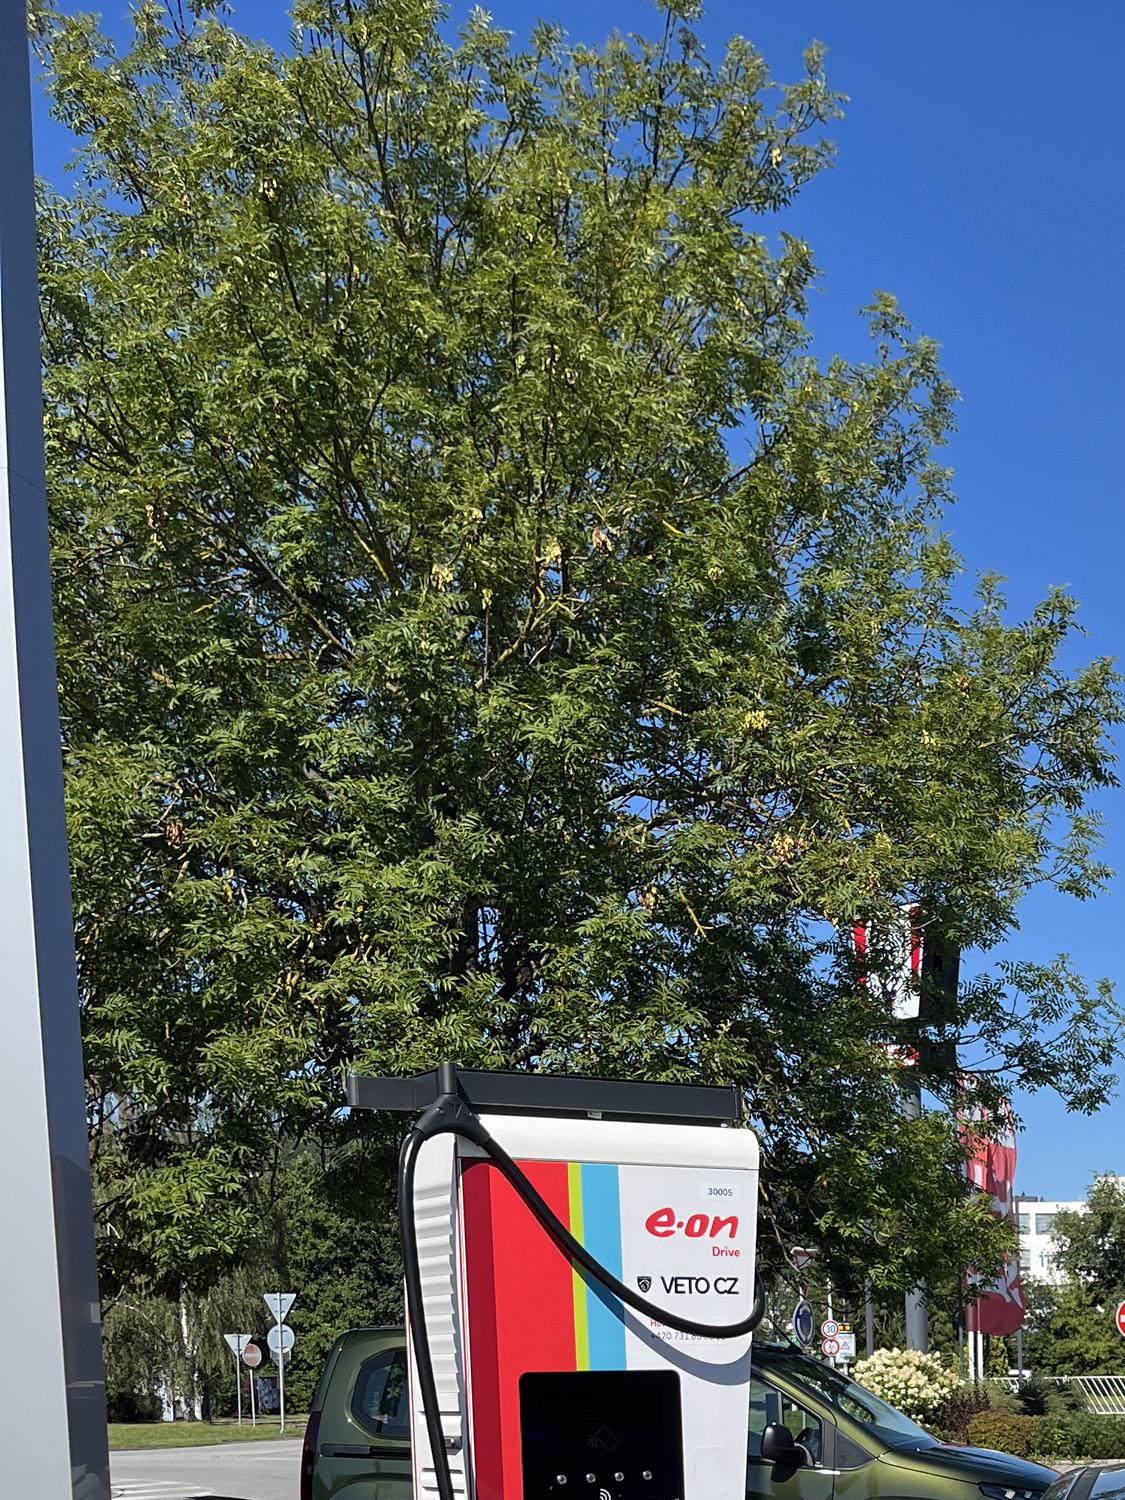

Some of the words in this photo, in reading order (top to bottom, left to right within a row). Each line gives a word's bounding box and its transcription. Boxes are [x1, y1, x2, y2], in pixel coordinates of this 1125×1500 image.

[707, 1187, 733, 1197] 30005
[712, 1246, 740, 1257] Drive
[660, 1276, 710, 1295] VETO
[714, 1277, 739, 1295] CZ
[825, 1325, 836, 1333] 30
